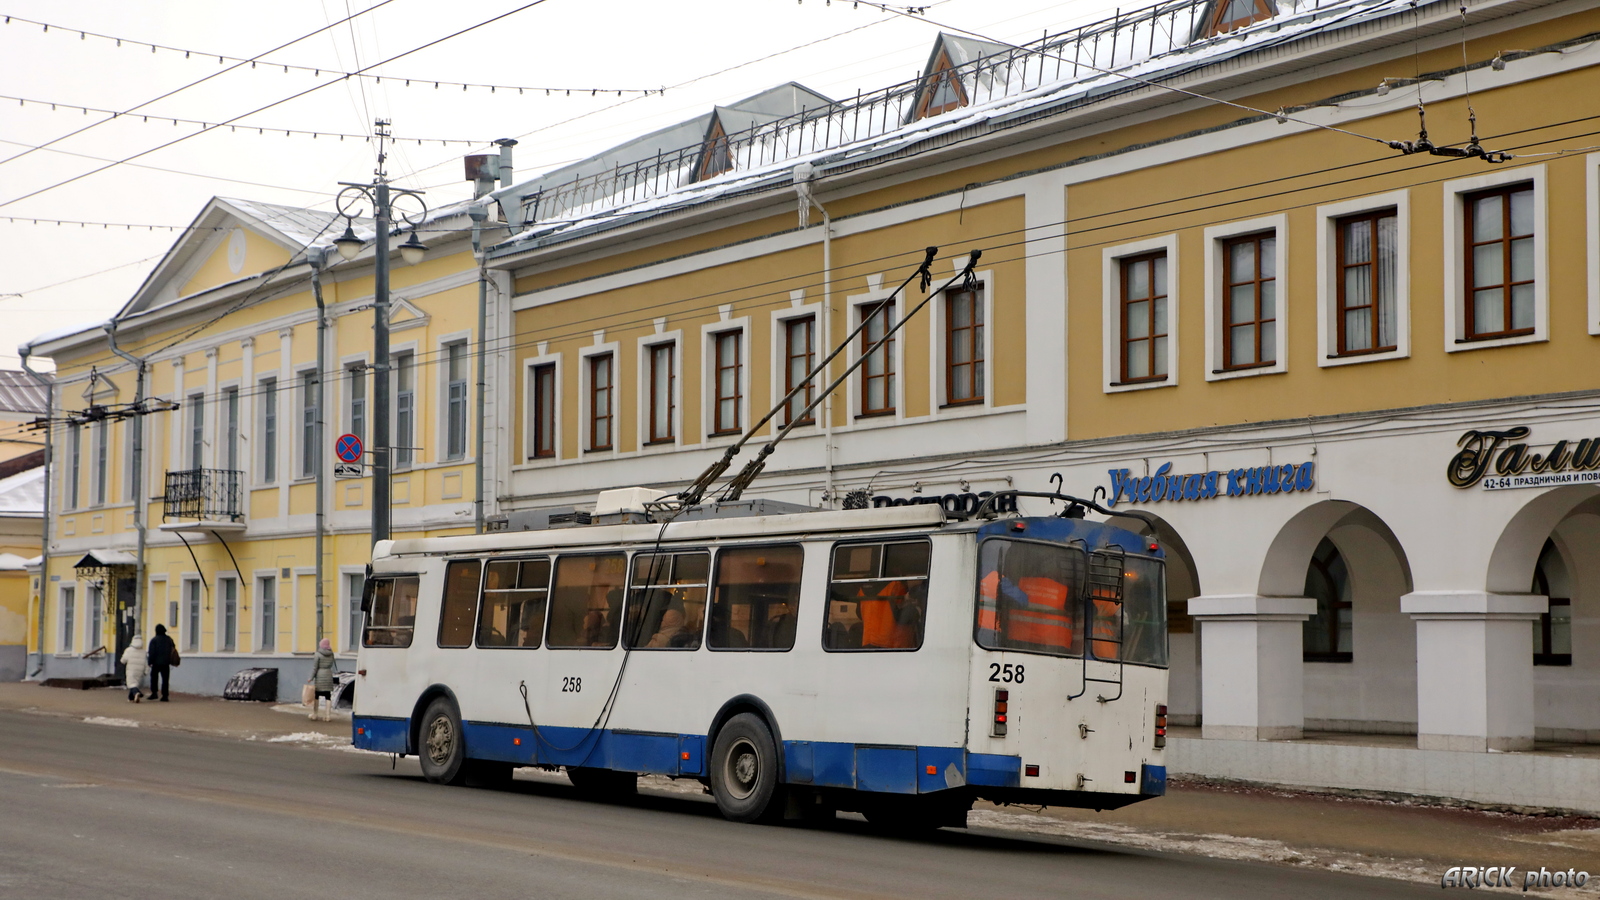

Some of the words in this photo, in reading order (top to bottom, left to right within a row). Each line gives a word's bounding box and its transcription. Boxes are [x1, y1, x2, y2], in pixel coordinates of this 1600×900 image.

[1107, 461, 1219, 508] Учебная
[1226, 461, 1314, 496] книга
[1484, 478, 1511, 489] 42-64
[1514, 474, 1571, 486] ПРАЗДНИЧНАЯ
[1573, 473, 1579, 481] И
[1581, 472, 1600, 481] ПОВ
[604, 558, 624, 574] 258
[988, 662, 1025, 684] 258
[561, 676, 582, 693] 258
